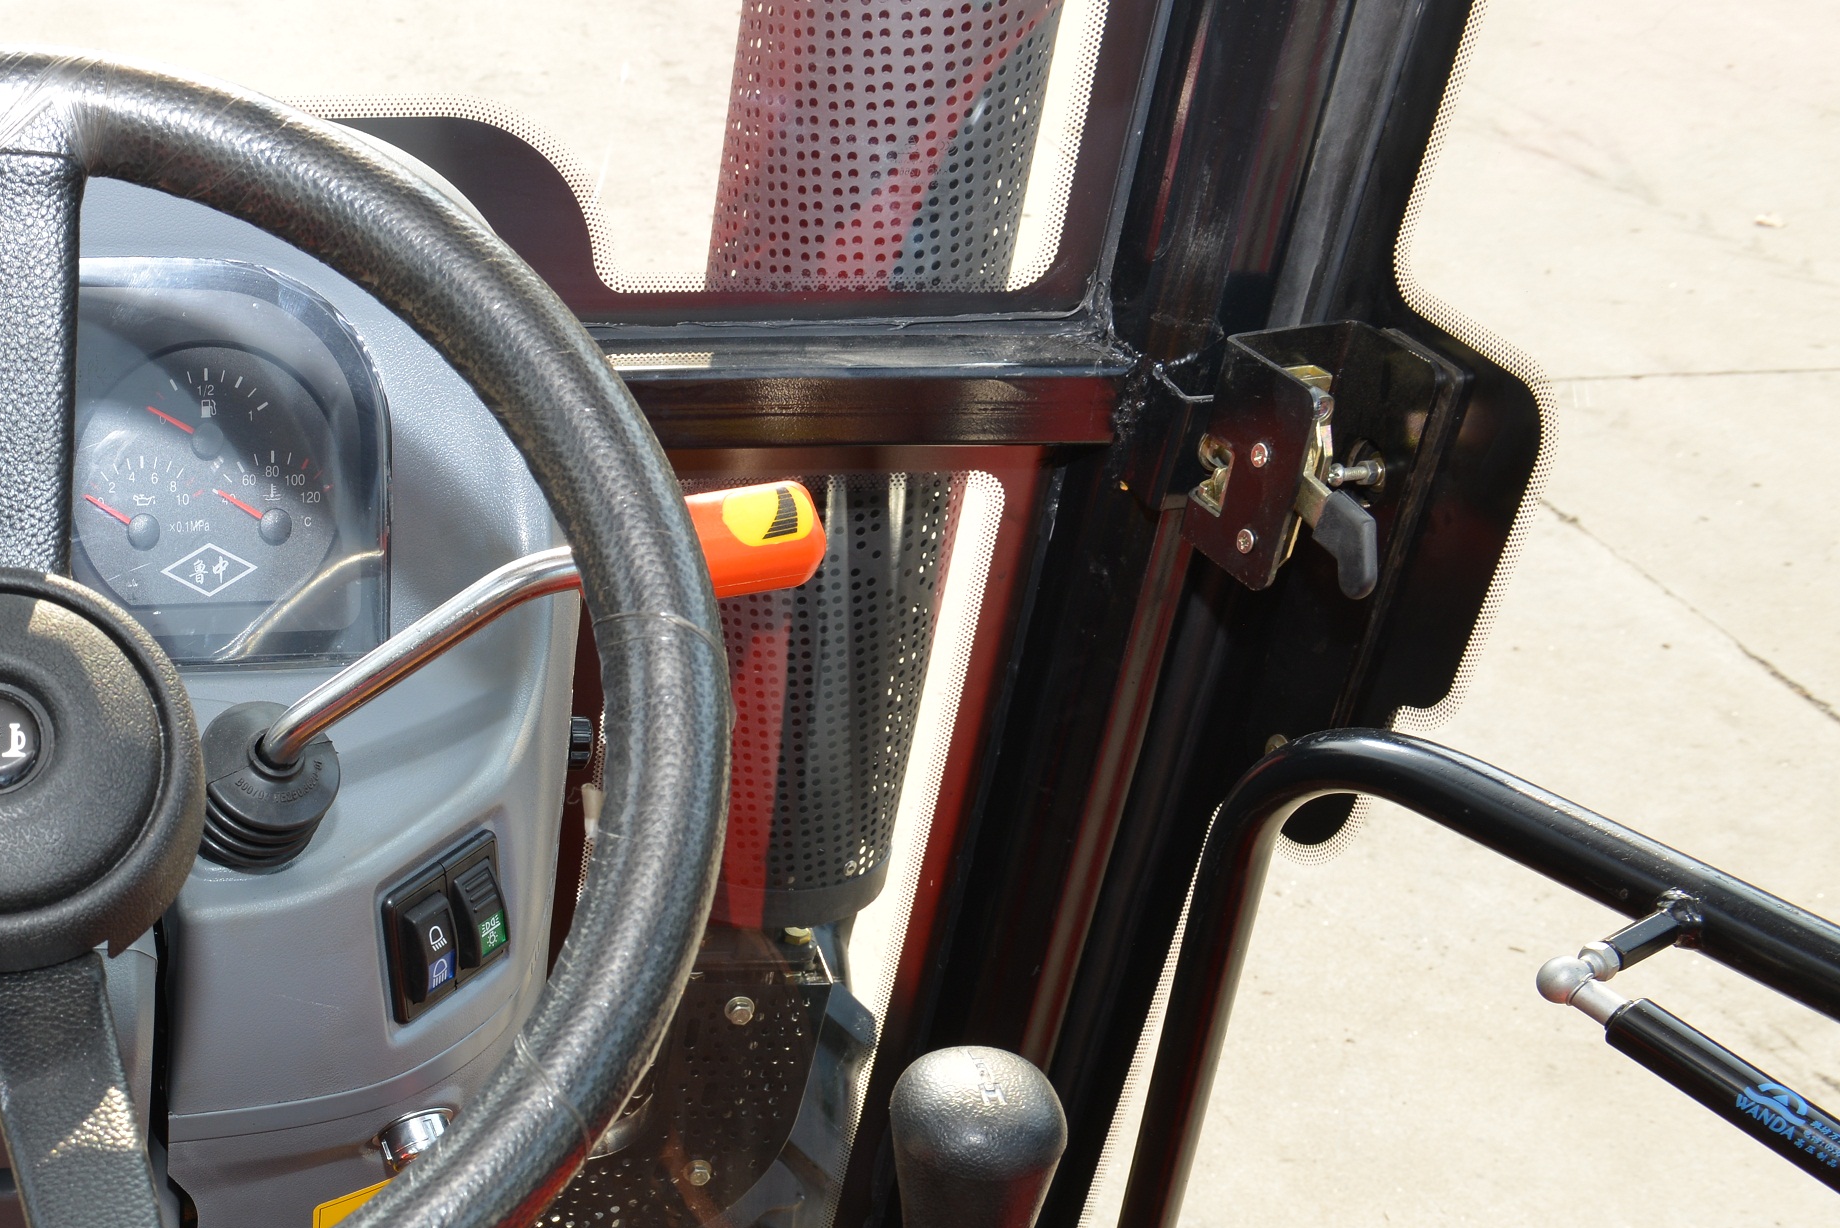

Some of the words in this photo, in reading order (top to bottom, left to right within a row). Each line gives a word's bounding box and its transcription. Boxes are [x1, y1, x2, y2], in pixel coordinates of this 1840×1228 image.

[197, 385, 215, 397] 1/2
[265, 466, 280, 477] 80
[128, 473, 136, 483] 4
[151, 473, 159, 484] 6
[242, 475, 257, 486] 60
[285, 475, 306, 486] 100
[109, 483, 116, 494] 2
[169, 481, 177, 492] 8
[176, 494, 190, 505] 10
[300, 492, 321, 503] 120
[189, 556, 230, 585] 鲁中
[1735, 1094, 1795, 1140] WANDA
